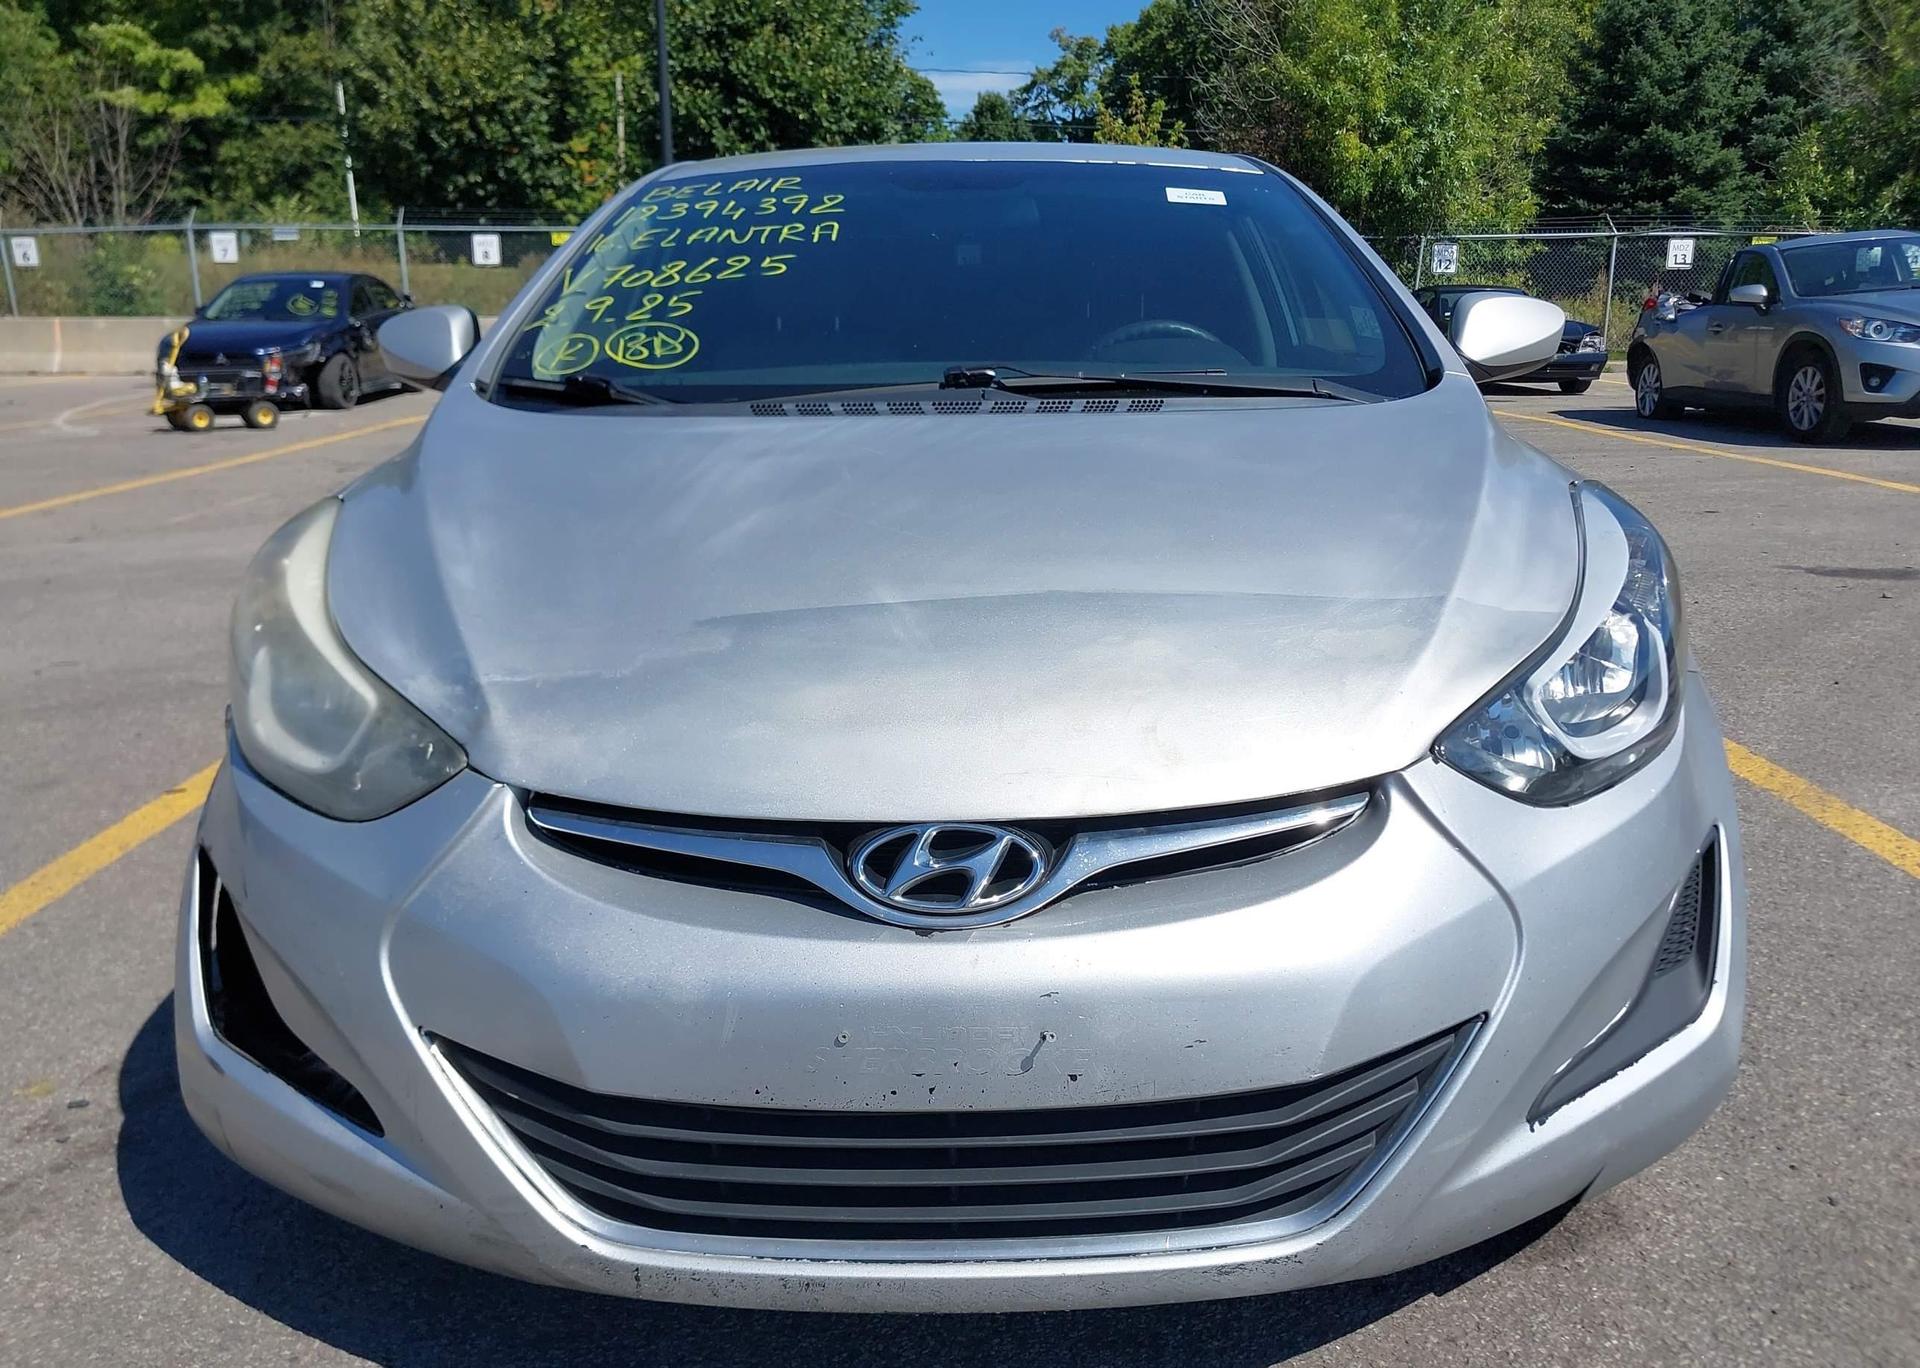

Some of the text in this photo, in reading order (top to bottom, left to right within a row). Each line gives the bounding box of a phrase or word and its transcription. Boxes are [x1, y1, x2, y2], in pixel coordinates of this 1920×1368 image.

[641, 176, 802, 203] BELAIR
[630, 221, 840, 250] ELANTRA
[602, 253, 798, 291] 708625
[1437, 259, 1452, 270] 12
[1673, 253, 1688, 265] 13
